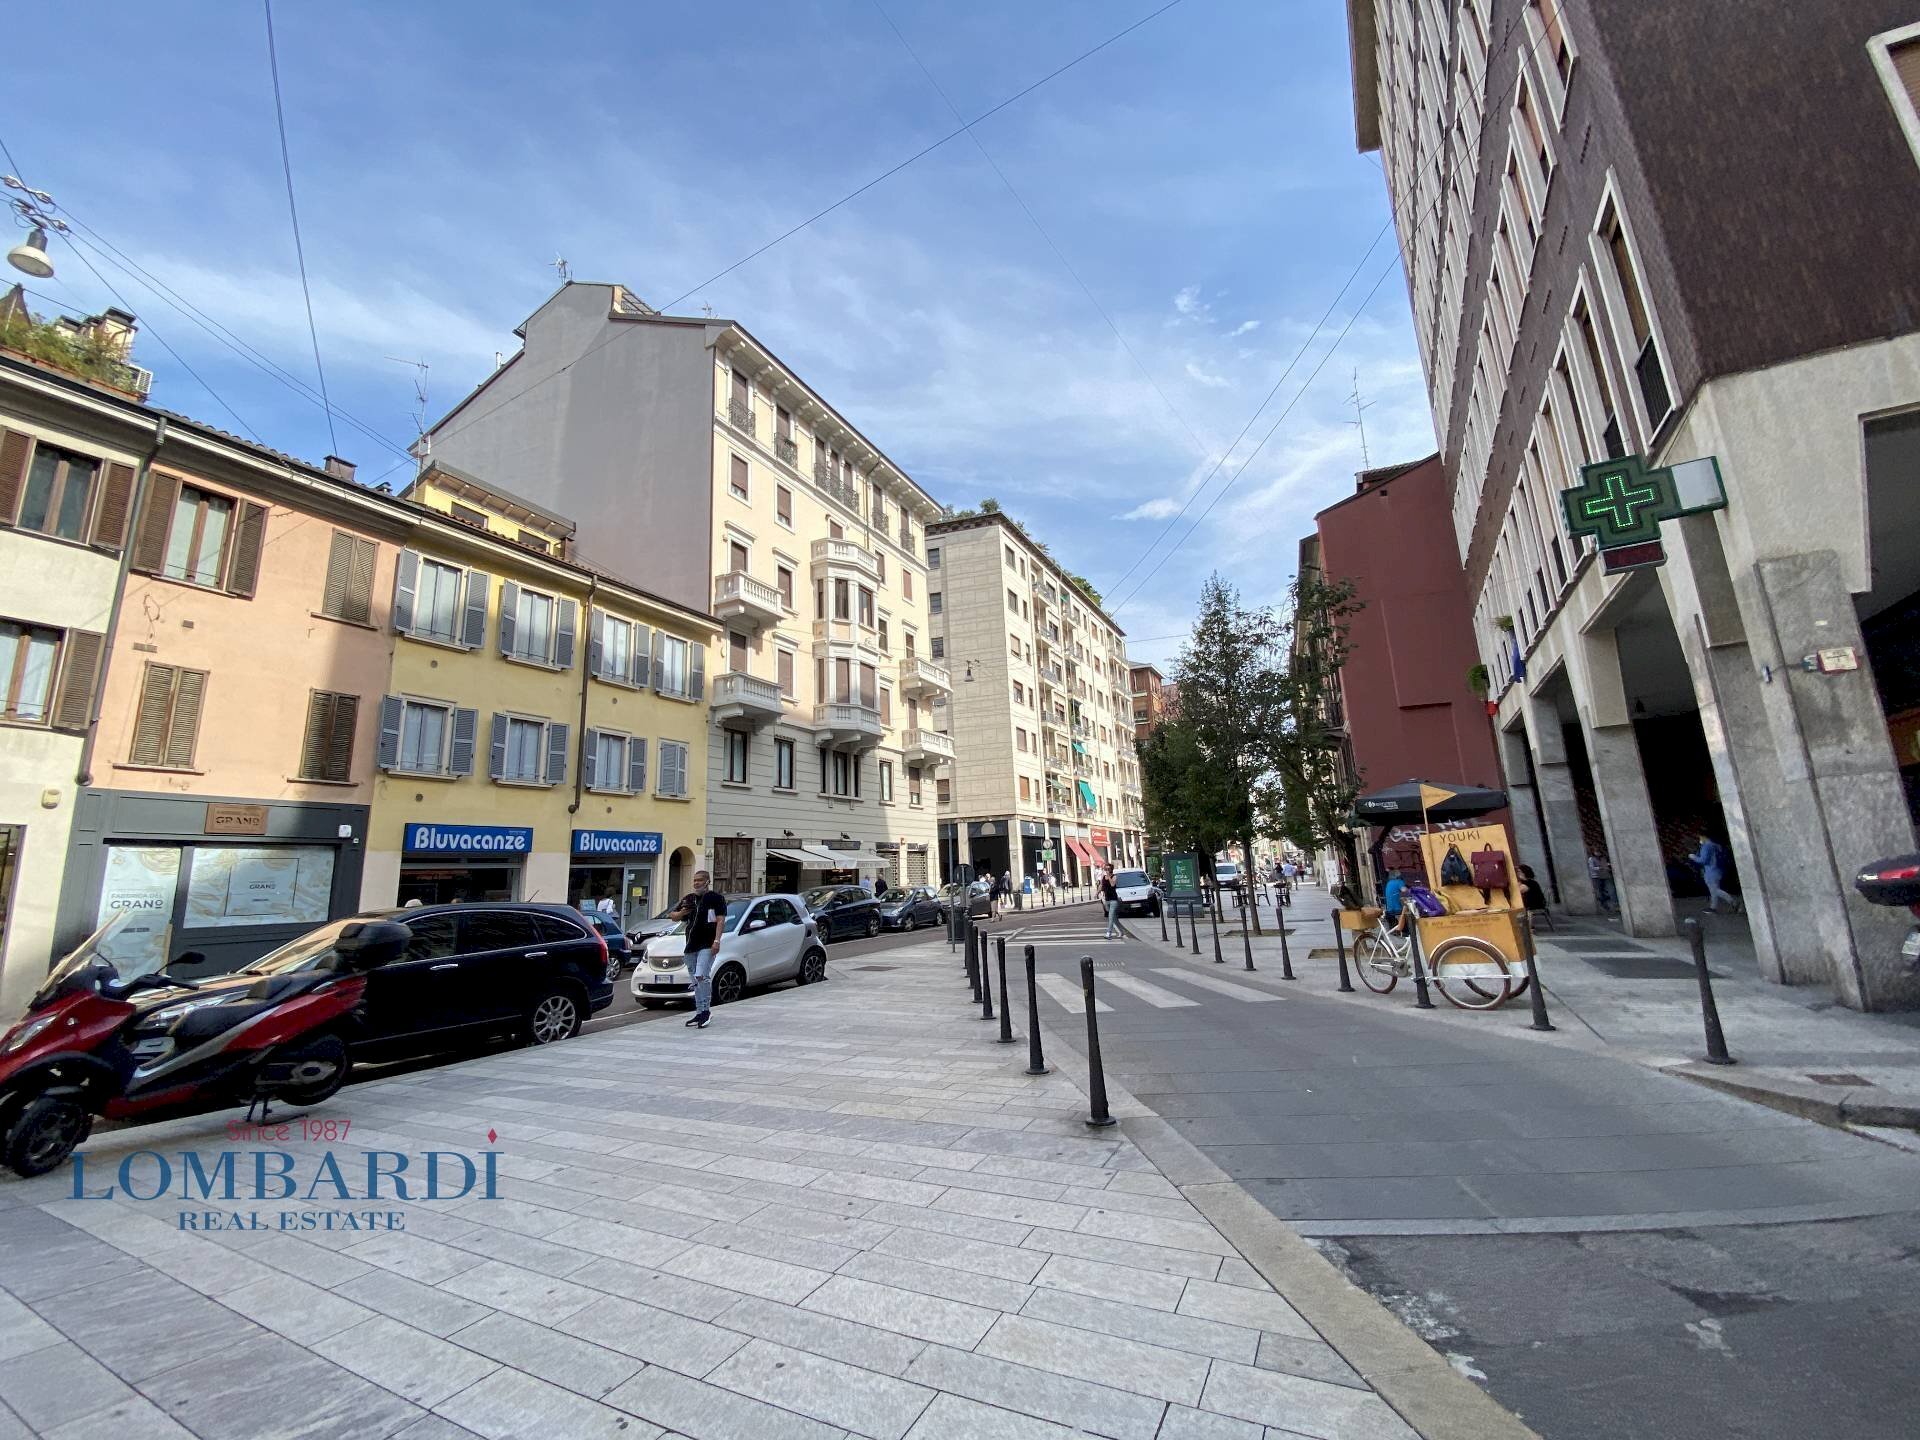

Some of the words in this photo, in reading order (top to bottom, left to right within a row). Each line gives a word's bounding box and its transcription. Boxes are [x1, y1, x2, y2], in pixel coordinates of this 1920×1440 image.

[414, 826, 526, 850] Bluvacanze
[580, 832, 658, 852] Bluvacanze
[1439, 829, 1480, 844] YOUKI
